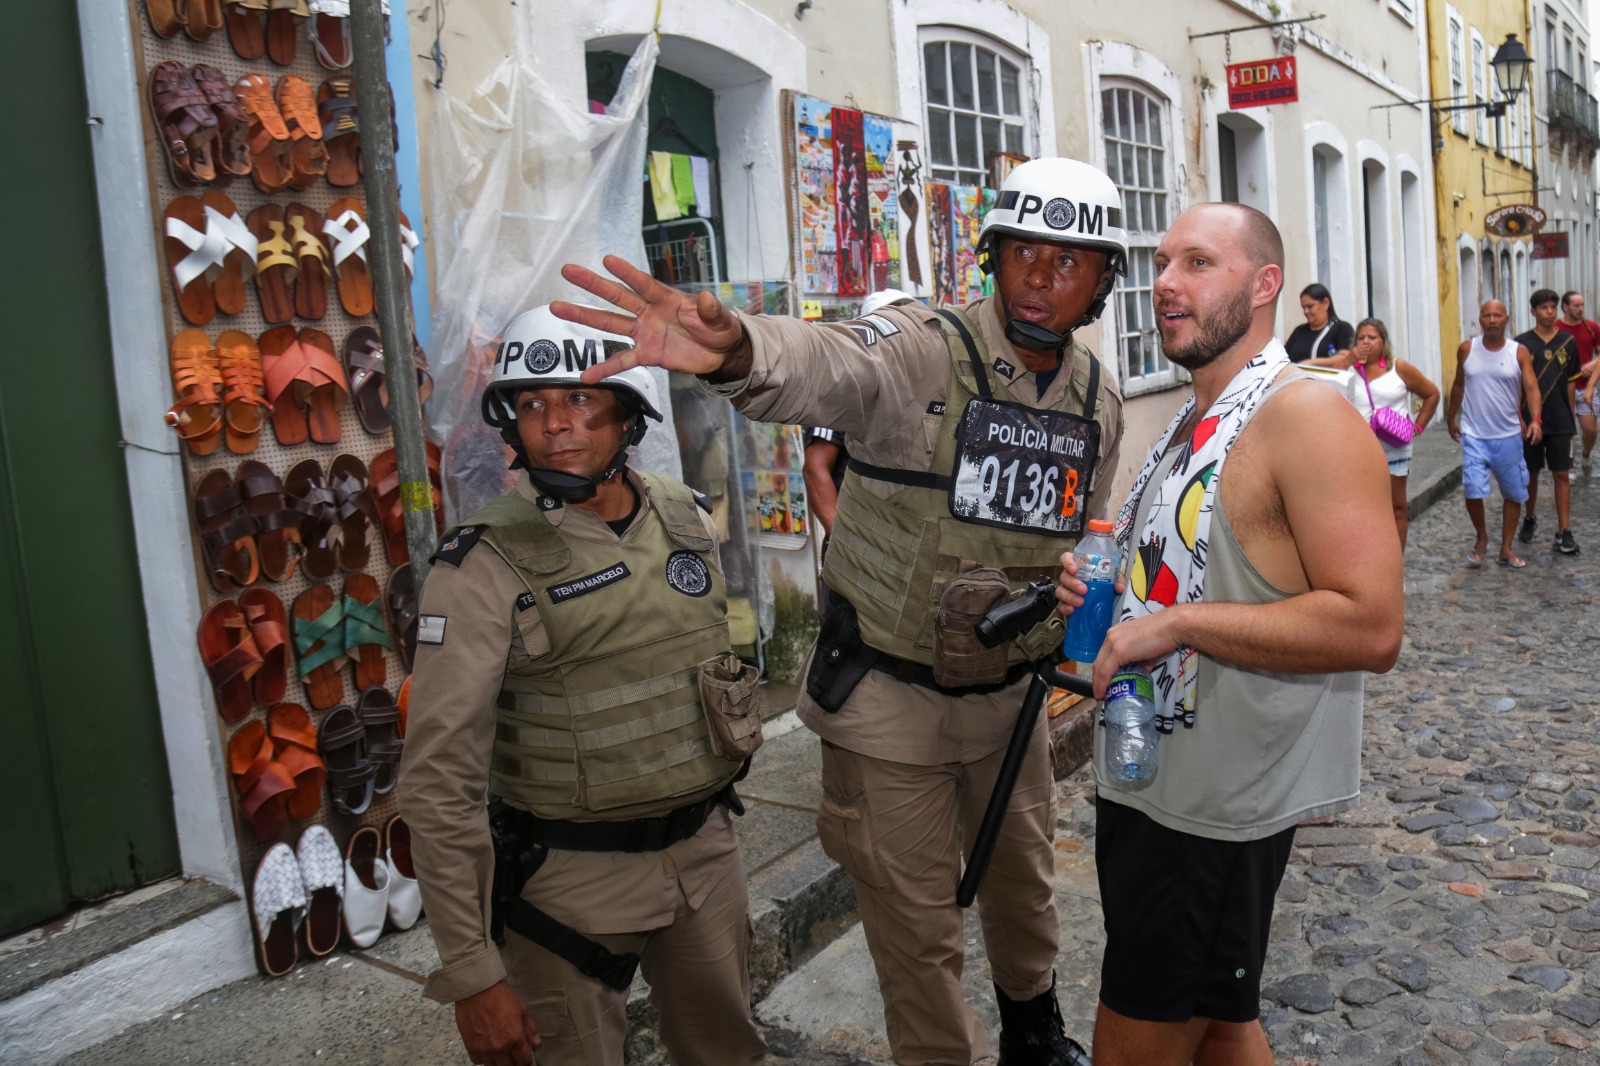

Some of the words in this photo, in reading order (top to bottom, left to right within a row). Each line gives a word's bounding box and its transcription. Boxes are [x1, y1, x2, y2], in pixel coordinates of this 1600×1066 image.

[987, 423, 1048, 451] POLÍCIA
[1050, 433, 1085, 458] MILITAR
[978, 455, 1059, 515] 0136
[1061, 469, 1079, 517] B
[554, 586, 572, 597] TEN
[572, 582, 586, 592] PM
[585, 566, 624, 587] MARCELO
